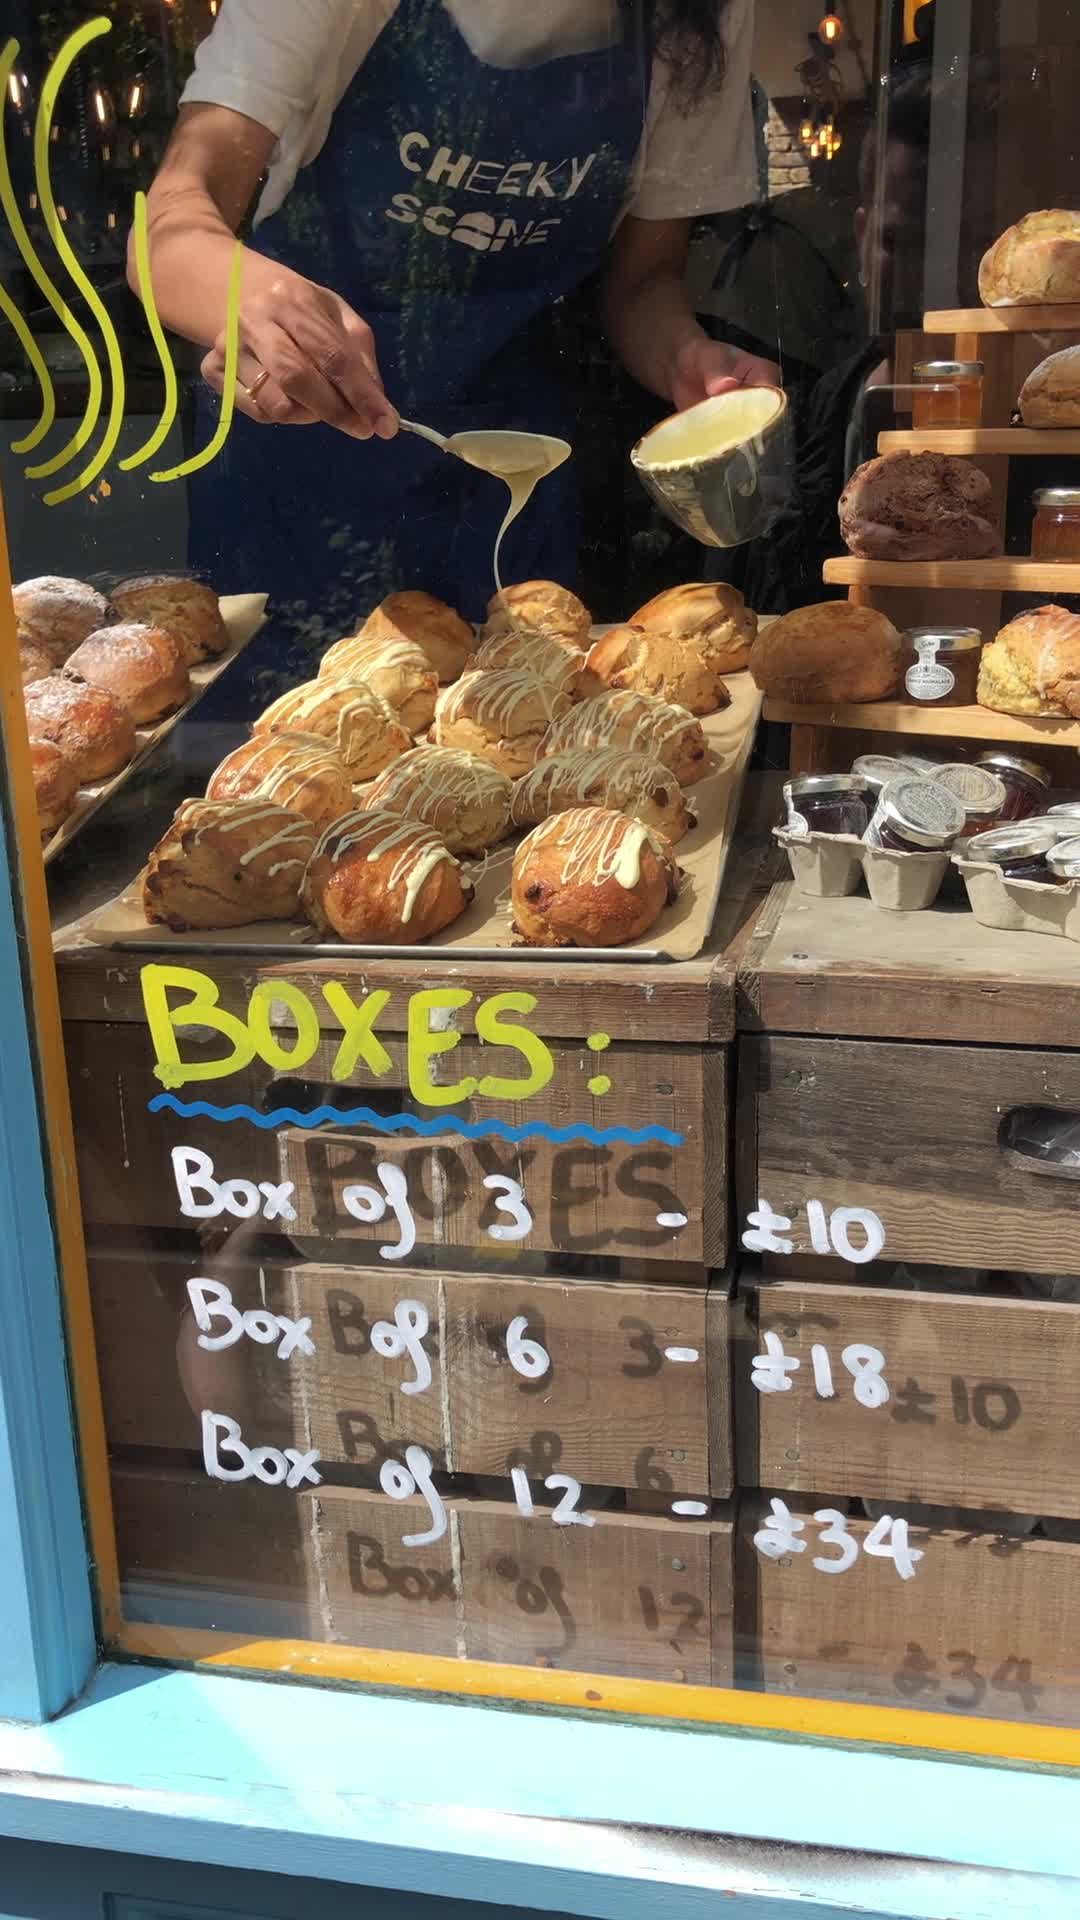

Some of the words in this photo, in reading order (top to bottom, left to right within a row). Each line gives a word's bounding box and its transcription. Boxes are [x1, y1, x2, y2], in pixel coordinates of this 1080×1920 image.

[384, 192, 561, 251] SCONE
[399, 131, 597, 200] CHEEKY
[140, 963, 612, 1107] BOXES:
[171, 1145, 298, 1220] Box
[342, 1162, 416, 1260] of
[483, 1174, 533, 1240] 3
[741, 1199, 886, 1264] £10
[186, 1277, 317, 1360] Box
[506, 1315, 550, 1378] 6
[750, 1331, 890, 1408] £18
[201, 1410, 322, 1489] Box
[379, 1445, 448, 1547] of
[510, 1467, 596, 1527] 12
[753, 1497, 925, 1580] £34
